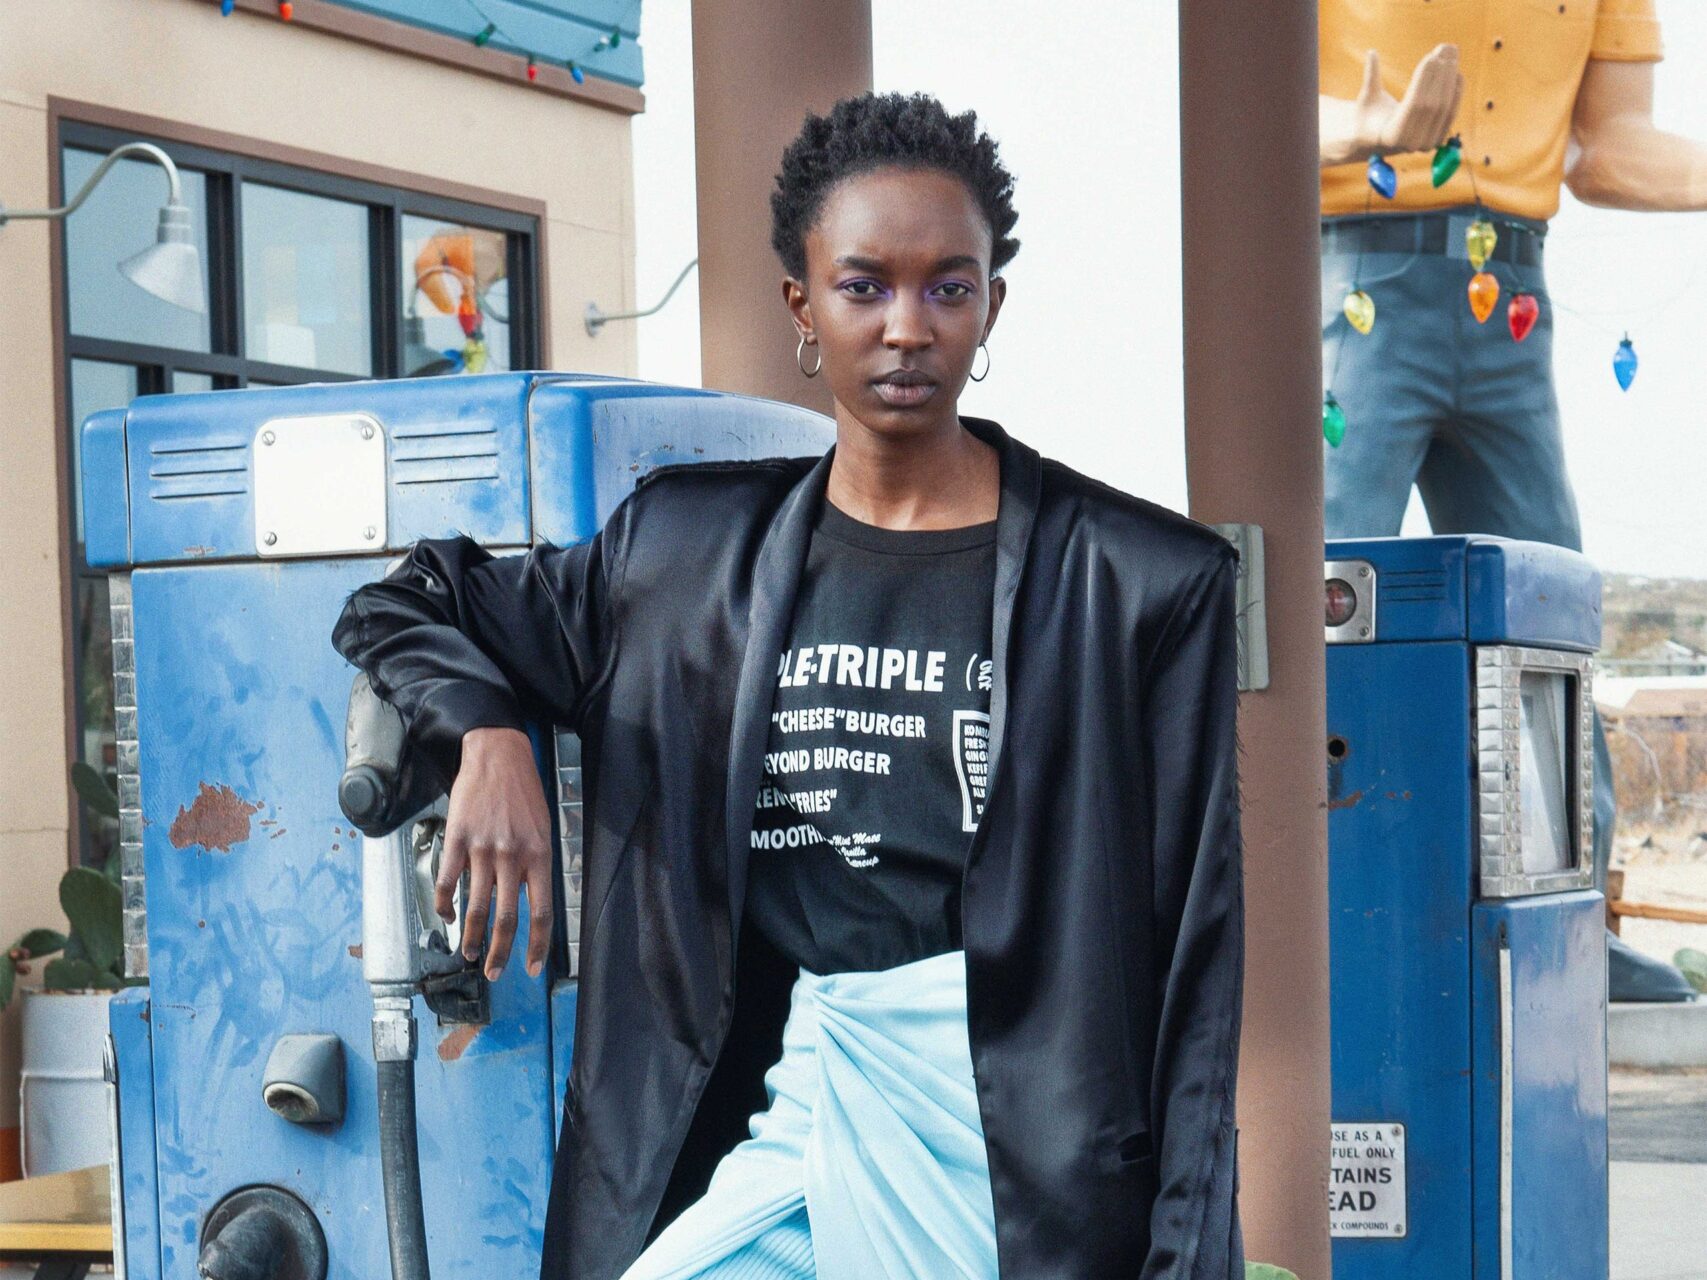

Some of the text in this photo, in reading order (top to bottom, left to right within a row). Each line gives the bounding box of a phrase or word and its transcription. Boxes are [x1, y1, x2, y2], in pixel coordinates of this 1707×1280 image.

[814, 746, 891, 775] BURGER
[1330, 1130, 1383, 1142] SE AS A
[1332, 1147, 1396, 1159] FUEL ONLY
[1331, 1166, 1393, 1185] TAINS
[1329, 1190, 1378, 1212] EAD
[1341, 1221, 1390, 1231] COMPOUNDS
